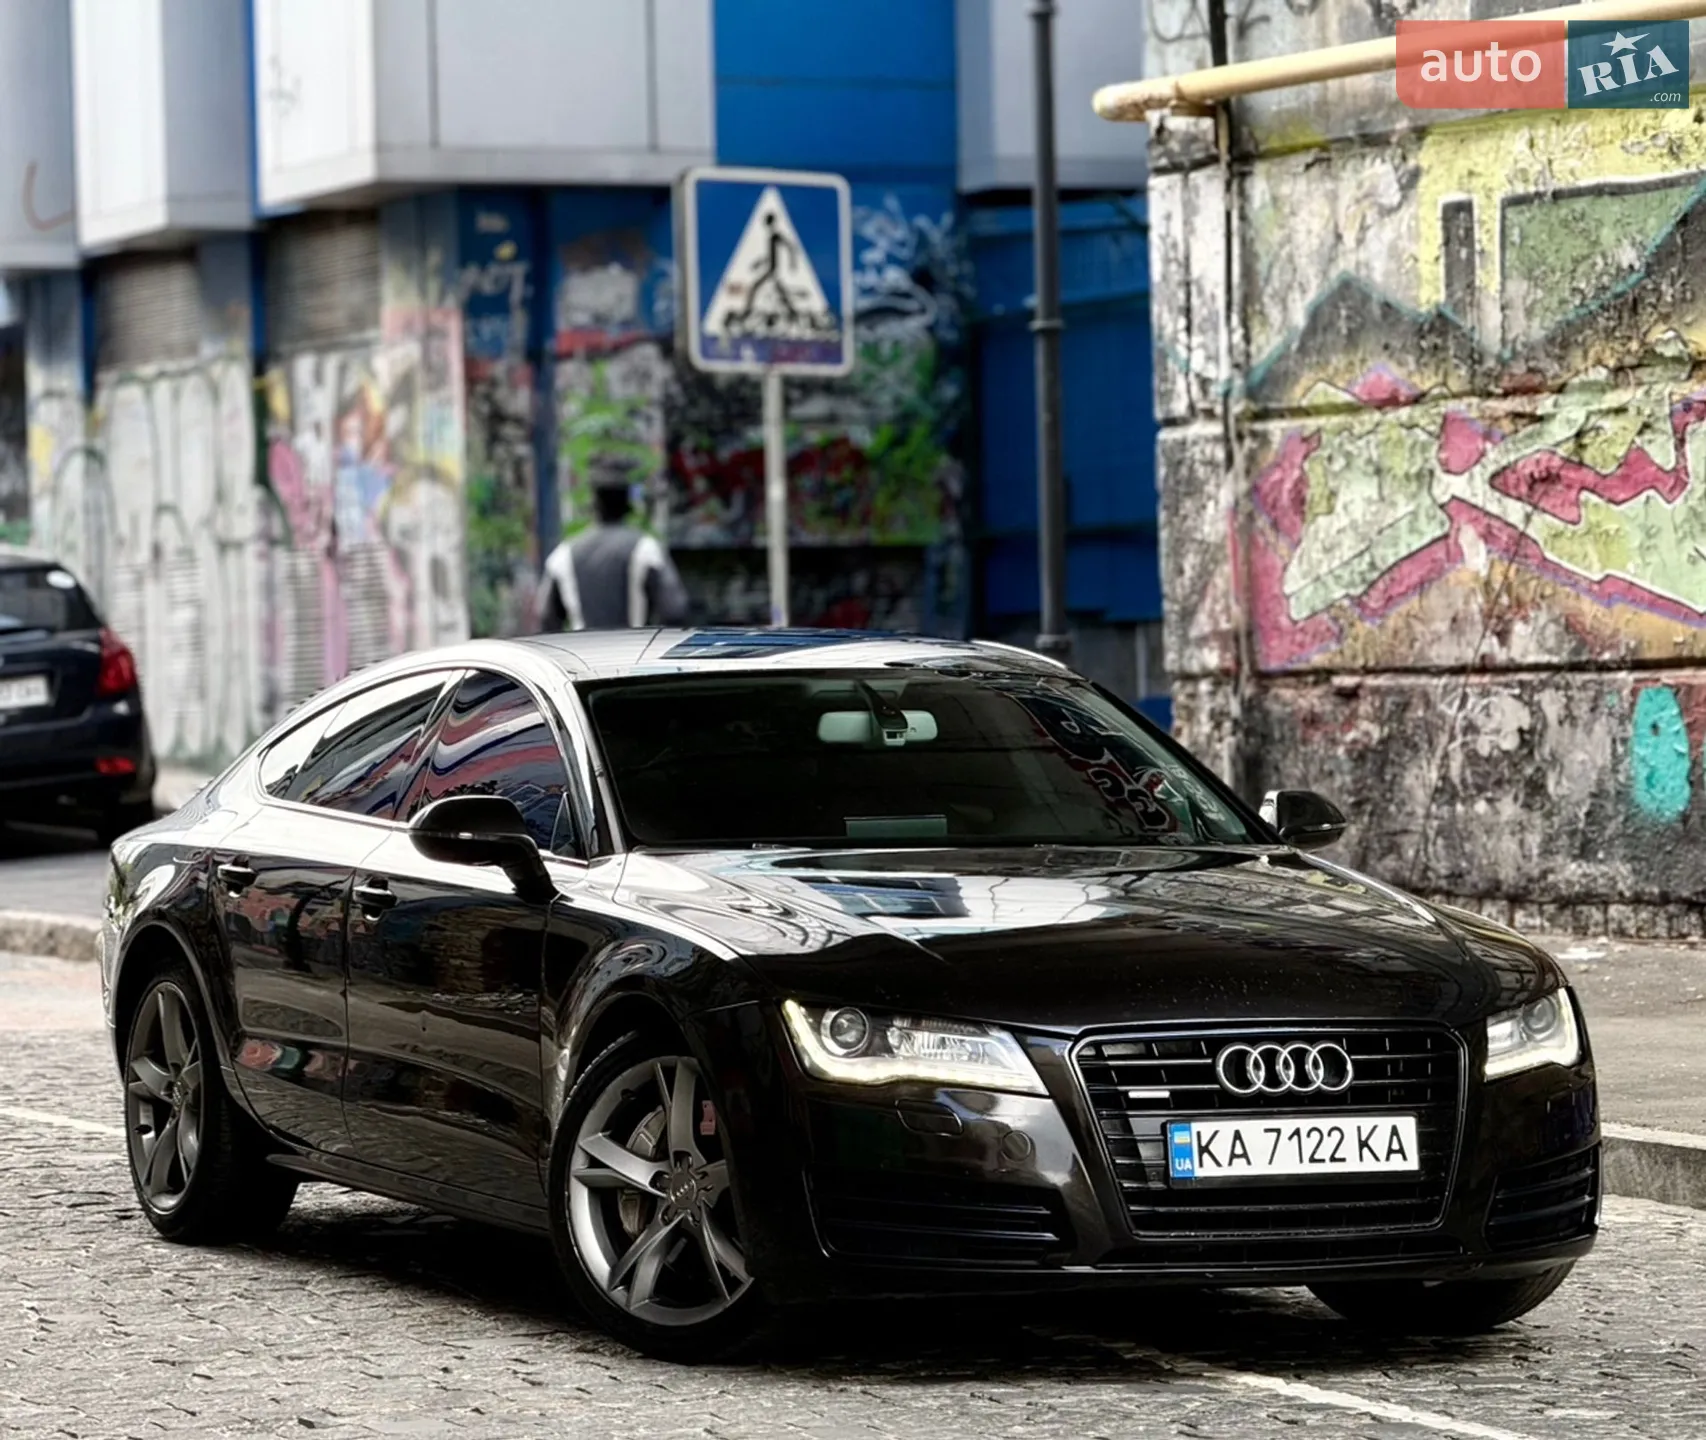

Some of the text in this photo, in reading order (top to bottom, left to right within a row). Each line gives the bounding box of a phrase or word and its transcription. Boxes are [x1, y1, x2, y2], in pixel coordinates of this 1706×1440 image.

[1196, 1124, 1408, 1168] KA 7122 KA
[1175, 1158, 1193, 1171] UA
